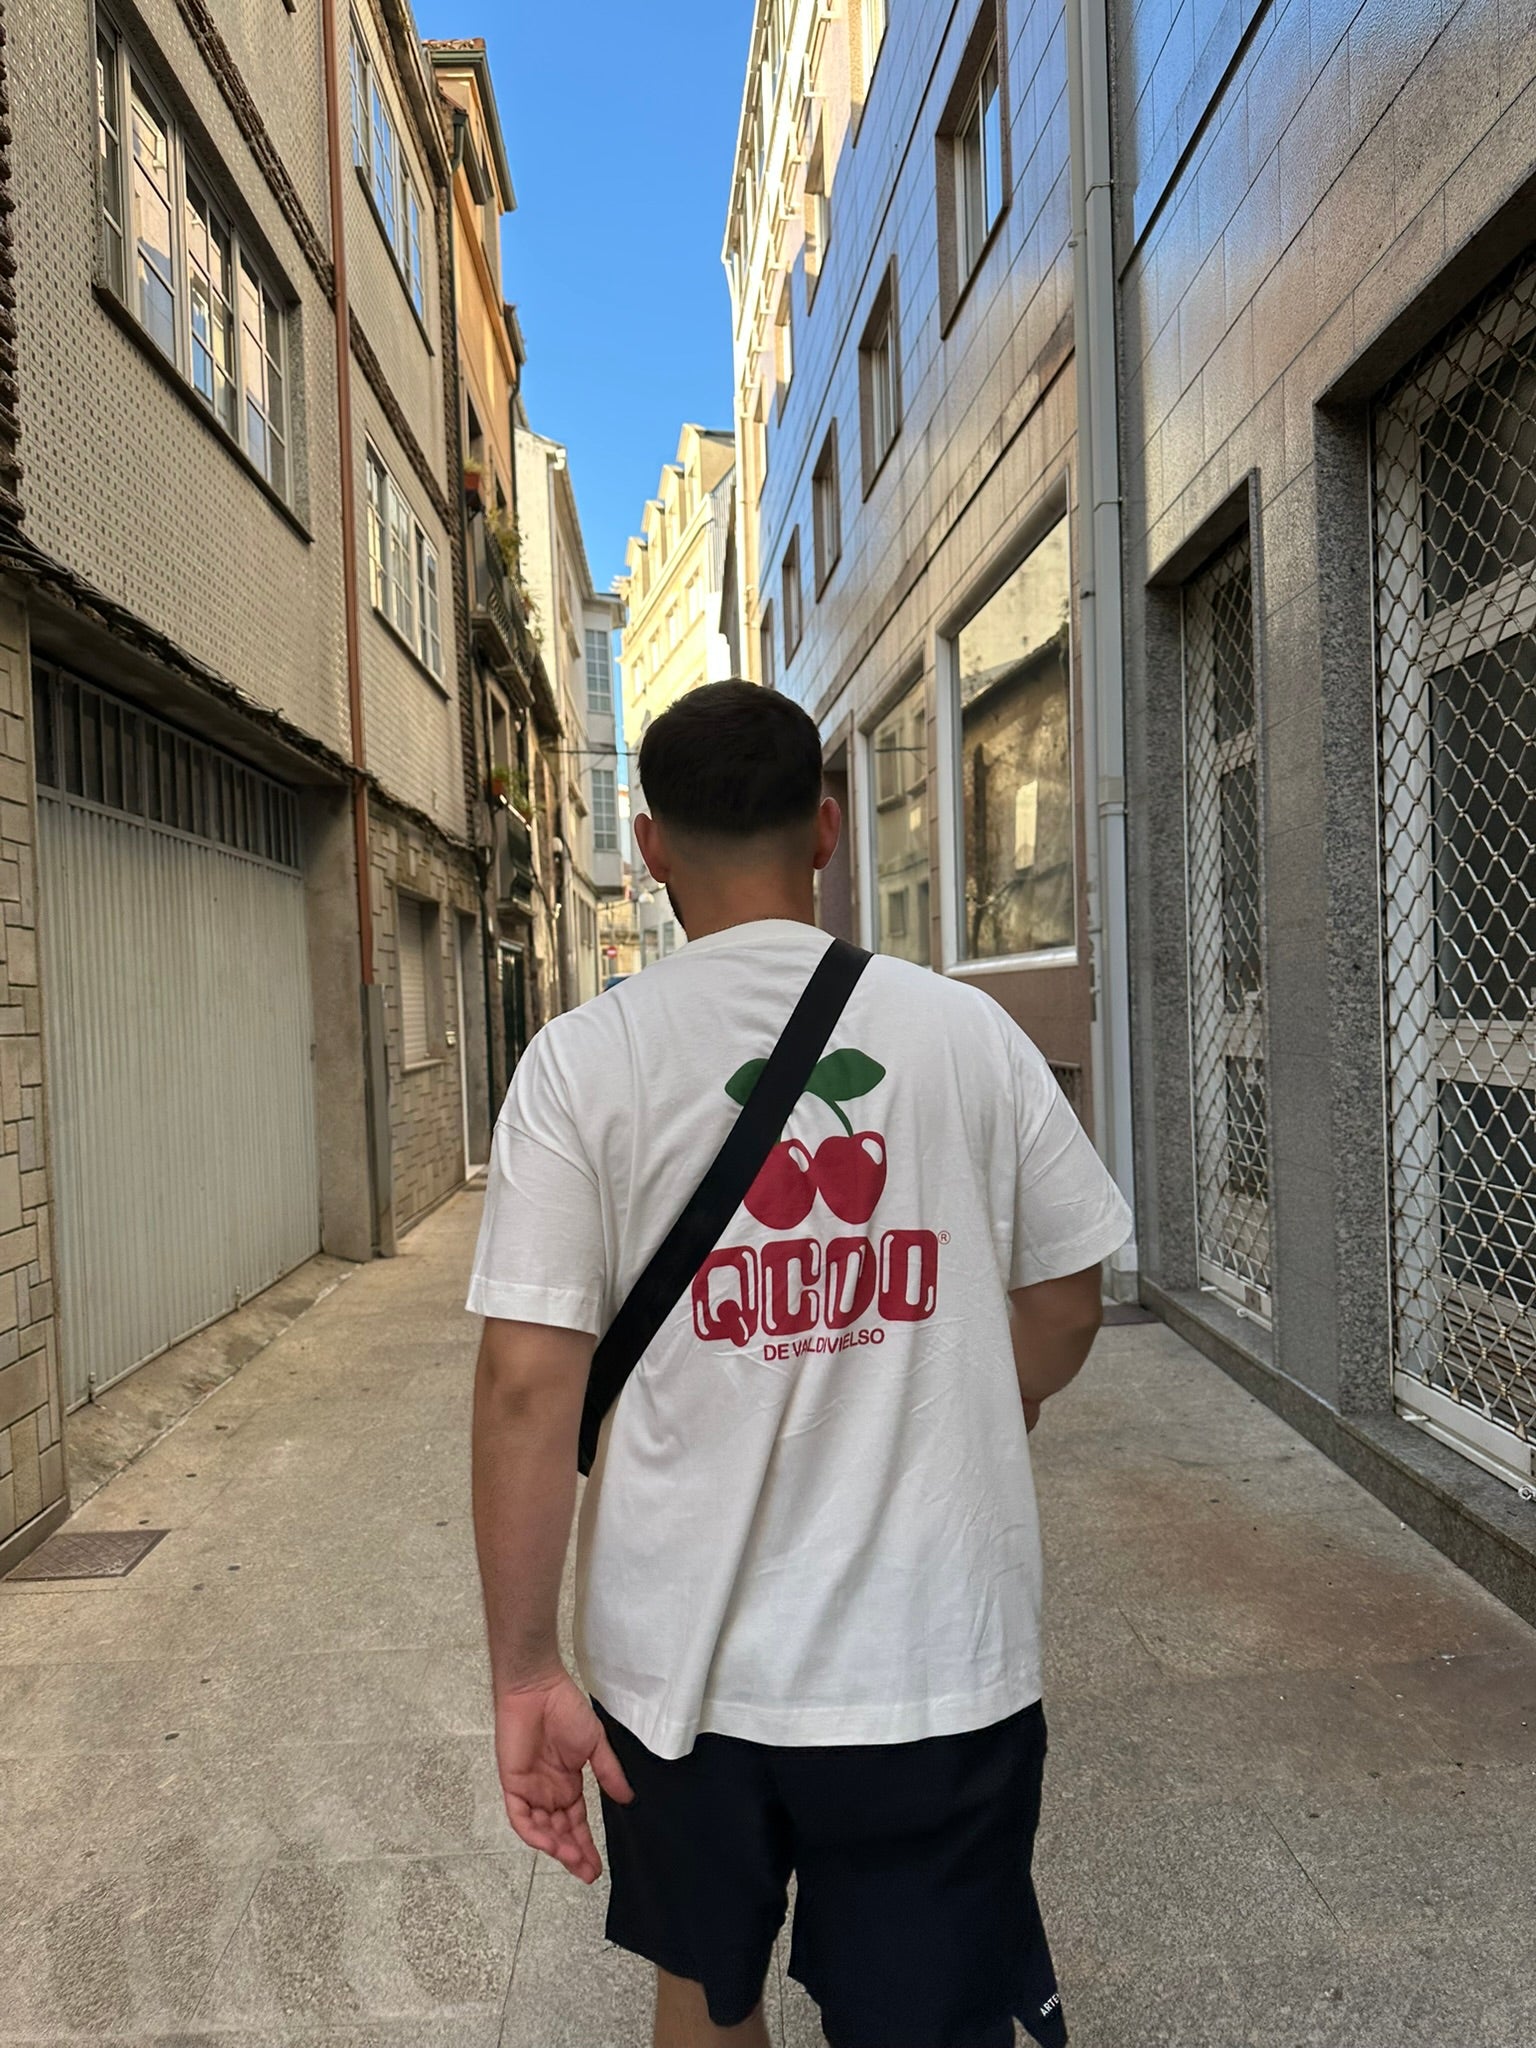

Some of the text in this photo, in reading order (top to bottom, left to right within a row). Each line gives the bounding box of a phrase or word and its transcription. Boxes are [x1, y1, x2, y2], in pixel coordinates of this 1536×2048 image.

[763, 1328, 885, 1361] DE VALDIVIELSO
[1039, 1992, 1060, 2017] ARTE
